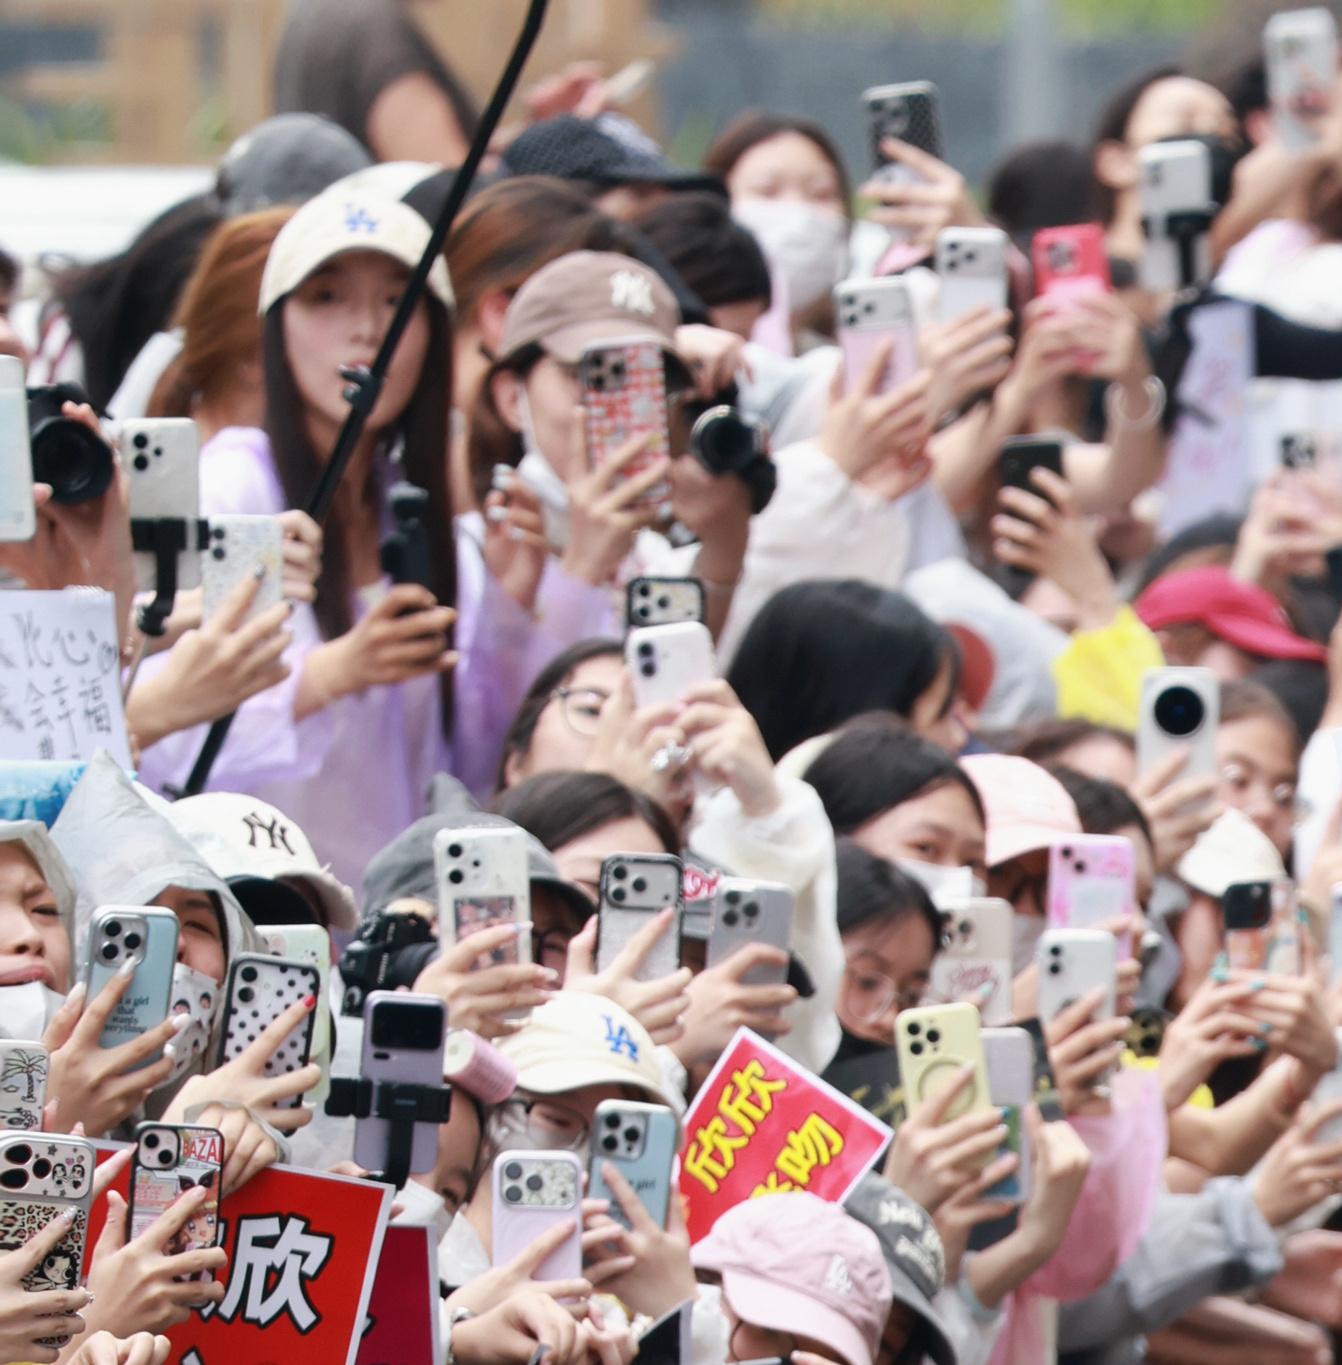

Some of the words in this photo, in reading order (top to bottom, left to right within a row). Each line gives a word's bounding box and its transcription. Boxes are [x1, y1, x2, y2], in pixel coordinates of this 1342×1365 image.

[183, 1137, 221, 1163] BAZA
[684, 1059, 787, 1194] 欣欣
[203, 1216, 332, 1332] 欣
